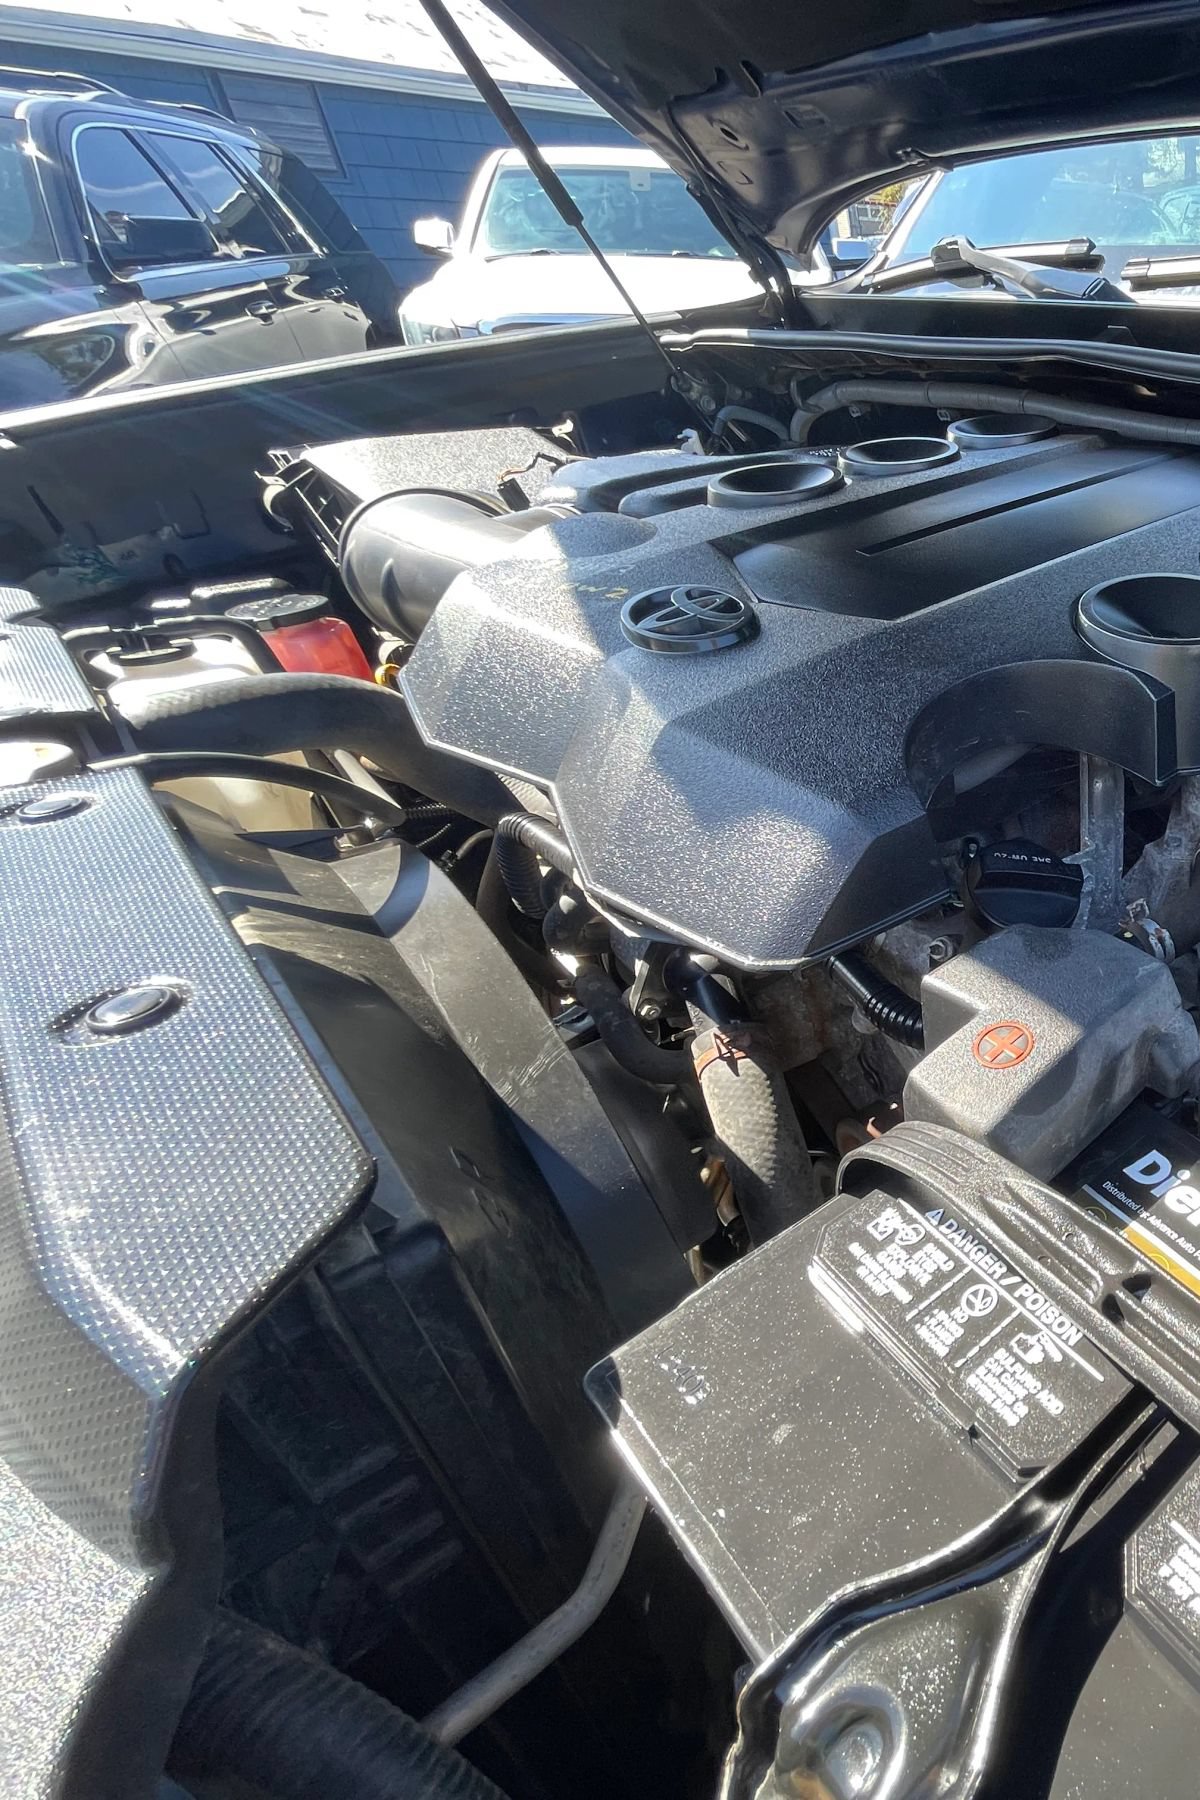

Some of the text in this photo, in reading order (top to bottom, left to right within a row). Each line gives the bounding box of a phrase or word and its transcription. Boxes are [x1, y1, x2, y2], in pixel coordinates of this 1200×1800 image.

[1102, 1181, 1141, 1210] Distributed
[1147, 1215, 1178, 1240] Advance
[1175, 1237, 1195, 1253] Auto
[935, 1218, 1007, 1279] DANGER
[1013, 1283, 1083, 1346] POISON
[991, 1348, 1064, 1416] SULFURIC ACID
